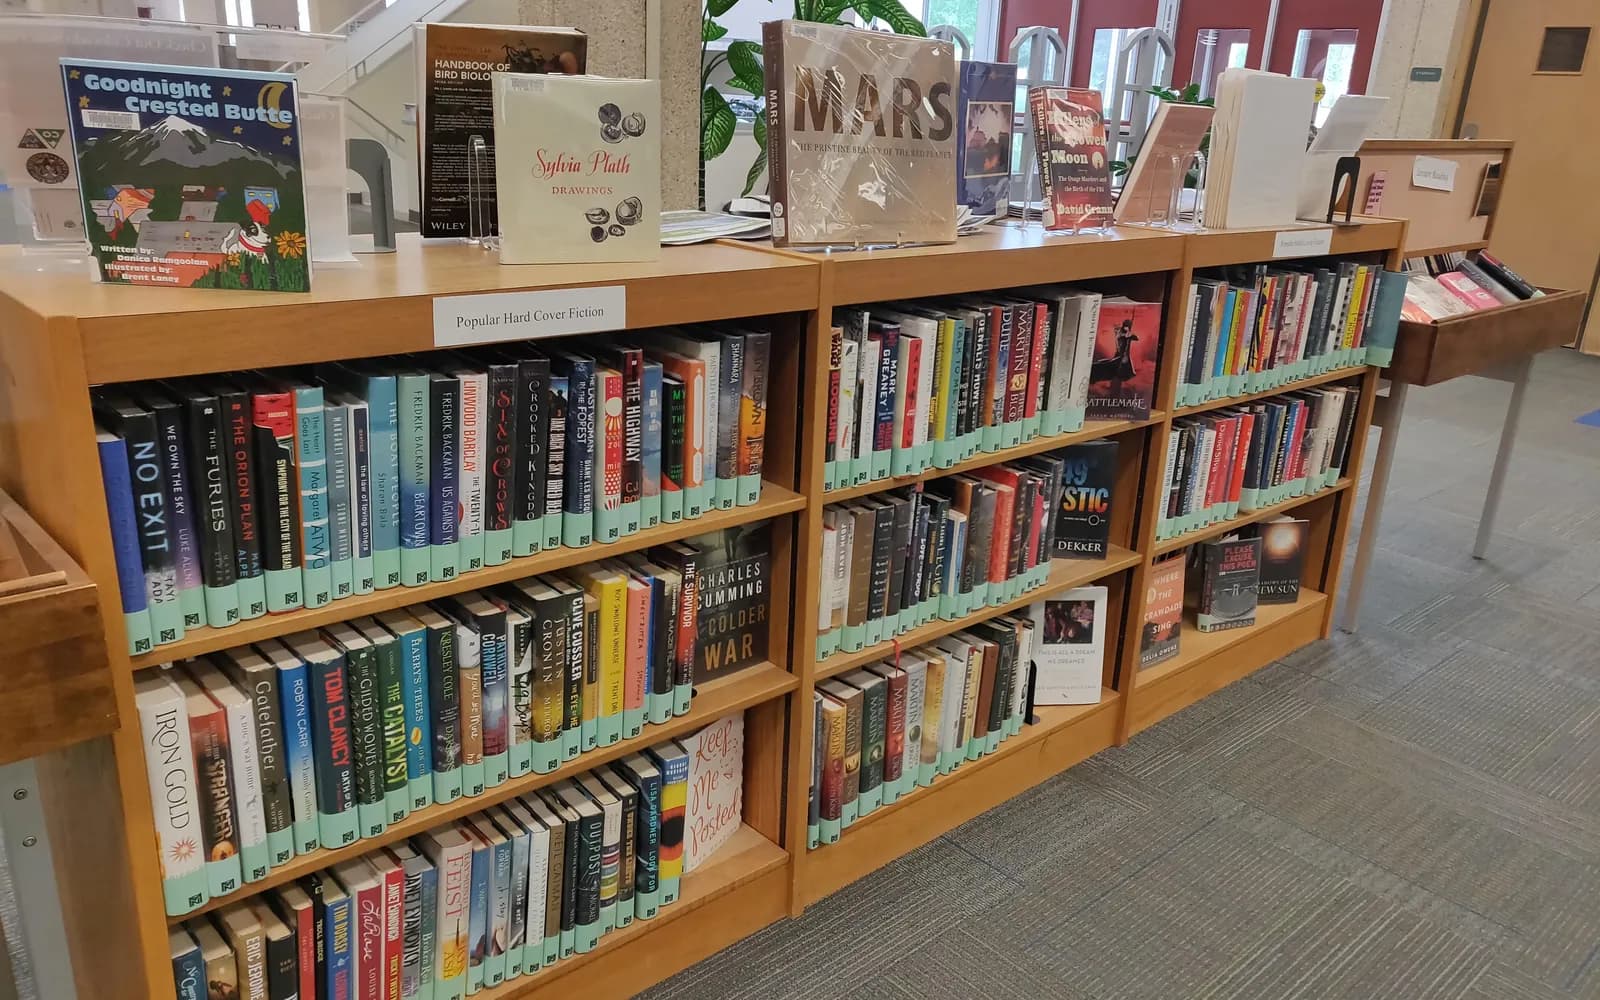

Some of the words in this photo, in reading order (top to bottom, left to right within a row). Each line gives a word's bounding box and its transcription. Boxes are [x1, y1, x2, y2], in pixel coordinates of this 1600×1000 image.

[435, 60, 494, 71] HANDBOOK
[497, 63, 511, 72] OF
[435, 70, 458, 79] BIRD
[461, 71, 491, 81] BIOLO
[84, 74, 212, 99] Goodnight
[793, 66, 952, 141] MARS
[125, 96, 221, 118] Crested
[225, 104, 293, 124] Butte
[769, 89, 778, 126] MARS
[531, 148, 581, 179] Sylvia
[589, 150, 631, 176] Plath
[814, 144, 851, 154] PRISTINE
[1051, 150, 1088, 164] Moon
[552, 186, 613, 195] DRAWINGS
[431, 222, 465, 230] WILEY
[1056, 203, 1084, 215] David
[1085, 203, 1113, 215] Grann
[100, 245, 137, 253] Written
[117, 254, 151, 263] Danica
[153, 256, 209, 266] Ramgoolam
[105, 263, 157, 273] Illustrated
[122, 273, 150, 281] Brent
[152, 275, 179, 283] Laney
[456, 314, 501, 330] Popular
[504, 310, 530, 325] Hard
[533, 309, 566, 322] Cover
[569, 306, 604, 319] Fiction
[1000, 312, 1012, 352] DUNE
[1013, 310, 1027, 371] MARTIN
[730, 343, 739, 384] SHANNARA
[880, 349, 891, 407] GREANEY
[889, 360, 897, 394] MARK
[463, 381, 476, 427] LINWOOD
[587, 388, 595, 410] LAST
[626, 380, 640, 402] THE
[828, 371, 840, 444] BLOODLINE
[413, 390, 424, 432] FREDRIK
[442, 392, 453, 431] FREDRIK
[528, 381, 541, 455] CROOKED
[576, 406, 586, 444] FOREST
[167, 425, 177, 441] WE
[208, 428, 217, 449] THE
[231, 416, 247, 446] THE
[586, 413, 595, 452] WOMAN
[626, 405, 640, 462] HIGHWAY
[1215, 424, 1226, 451] Daniel
[133, 441, 160, 482] NO
[169, 444, 180, 469] OWN
[414, 435, 424, 485] BACKMAN
[442, 433, 453, 479] BACKMAN
[463, 430, 476, 472] BARCLAY
[1212, 452, 1222, 473] Silva
[172, 473, 183, 493] THE
[234, 450, 250, 498] ORION
[276, 459, 288, 493] SYMPHONY
[360, 465, 368, 478] the
[174, 496, 185, 515] SKY
[206, 455, 226, 532] FURIES
[279, 494, 289, 506] FOR
[307, 471, 321, 520] Margaret
[442, 486, 453, 498] US
[1061, 485, 1110, 513] STIC
[140, 491, 168, 552] EXIT
[240, 503, 254, 541] PLAN
[279, 507, 290, 518] THE
[280, 519, 291, 533] CITY
[360, 504, 369, 526] loving
[413, 492, 426, 547] BEARTOWN
[442, 501, 453, 533] AGAINST
[179, 528, 191, 552] LUKE
[281, 541, 292, 553] THE
[1057, 540, 1102, 553] DEKKER
[1224, 544, 1254, 554] PLEASE
[282, 553, 293, 569] DEAD
[685, 562, 695, 580] THE
[1219, 563, 1236, 572] THIS
[1237, 559, 1258, 569] POEM
[1224, 554, 1253, 563] EXCUSE
[699, 562, 761, 591] CHARLES
[1153, 571, 1179, 585] WHERE
[1278, 584, 1297, 593] SUN
[683, 582, 694, 628] SURVIVOR
[1144, 600, 1182, 621] CRAWDADS
[1157, 590, 1173, 601] THE
[572, 597, 583, 630] CLIVE
[708, 603, 766, 637] COLDER
[1152, 622, 1172, 634] SING
[410, 639, 423, 683] HARRY'S
[439, 630, 453, 674] KRESLEY
[482, 634, 496, 688] CORNWELL
[497, 633, 507, 681] PATRICIA
[543, 620, 552, 682] CRONIN
[572, 630, 583, 680] CUSSLER
[704, 633, 753, 671] WAR
[293, 678, 305, 716] ROBYN
[325, 668, 347, 703] TOM
[359, 678, 373, 720] GILDED
[388, 681, 401, 702] THE
[443, 676, 454, 701] COLE
[909, 678, 919, 724] MARTIN
[415, 688, 424, 722] TREES
[869, 695, 878, 743] MARTIN
[892, 688, 903, 734] MARTIN
[151, 708, 182, 764] IRON
[255, 680, 277, 771] Gatefather
[297, 719, 308, 748] CARR
[327, 705, 351, 767] CLANCY
[831, 716, 841, 755] MARTIN
[847, 707, 858, 755] MARTIN
[364, 723, 377, 766] WOLVES
[384, 704, 408, 784] CATALYST
[694, 720, 733, 775] Keep
[342, 770, 350, 792] OATH
[649, 782, 657, 801] LISA
[692, 769, 719, 816] Me
[164, 769, 190, 829] GOLD
[206, 758, 233, 839] STRANGER
[649, 804, 657, 845] GARDNER
[689, 788, 740, 857] Posted
[589, 822, 601, 876] OUTPOST
[404, 872, 422, 905] JANET
[446, 856, 464, 920] FEIST
[649, 875, 657, 892] FOR
[362, 899, 382, 963] LaRose
[403, 905, 421, 968] EVANOVICH
[246, 936, 261, 961] ERIC
